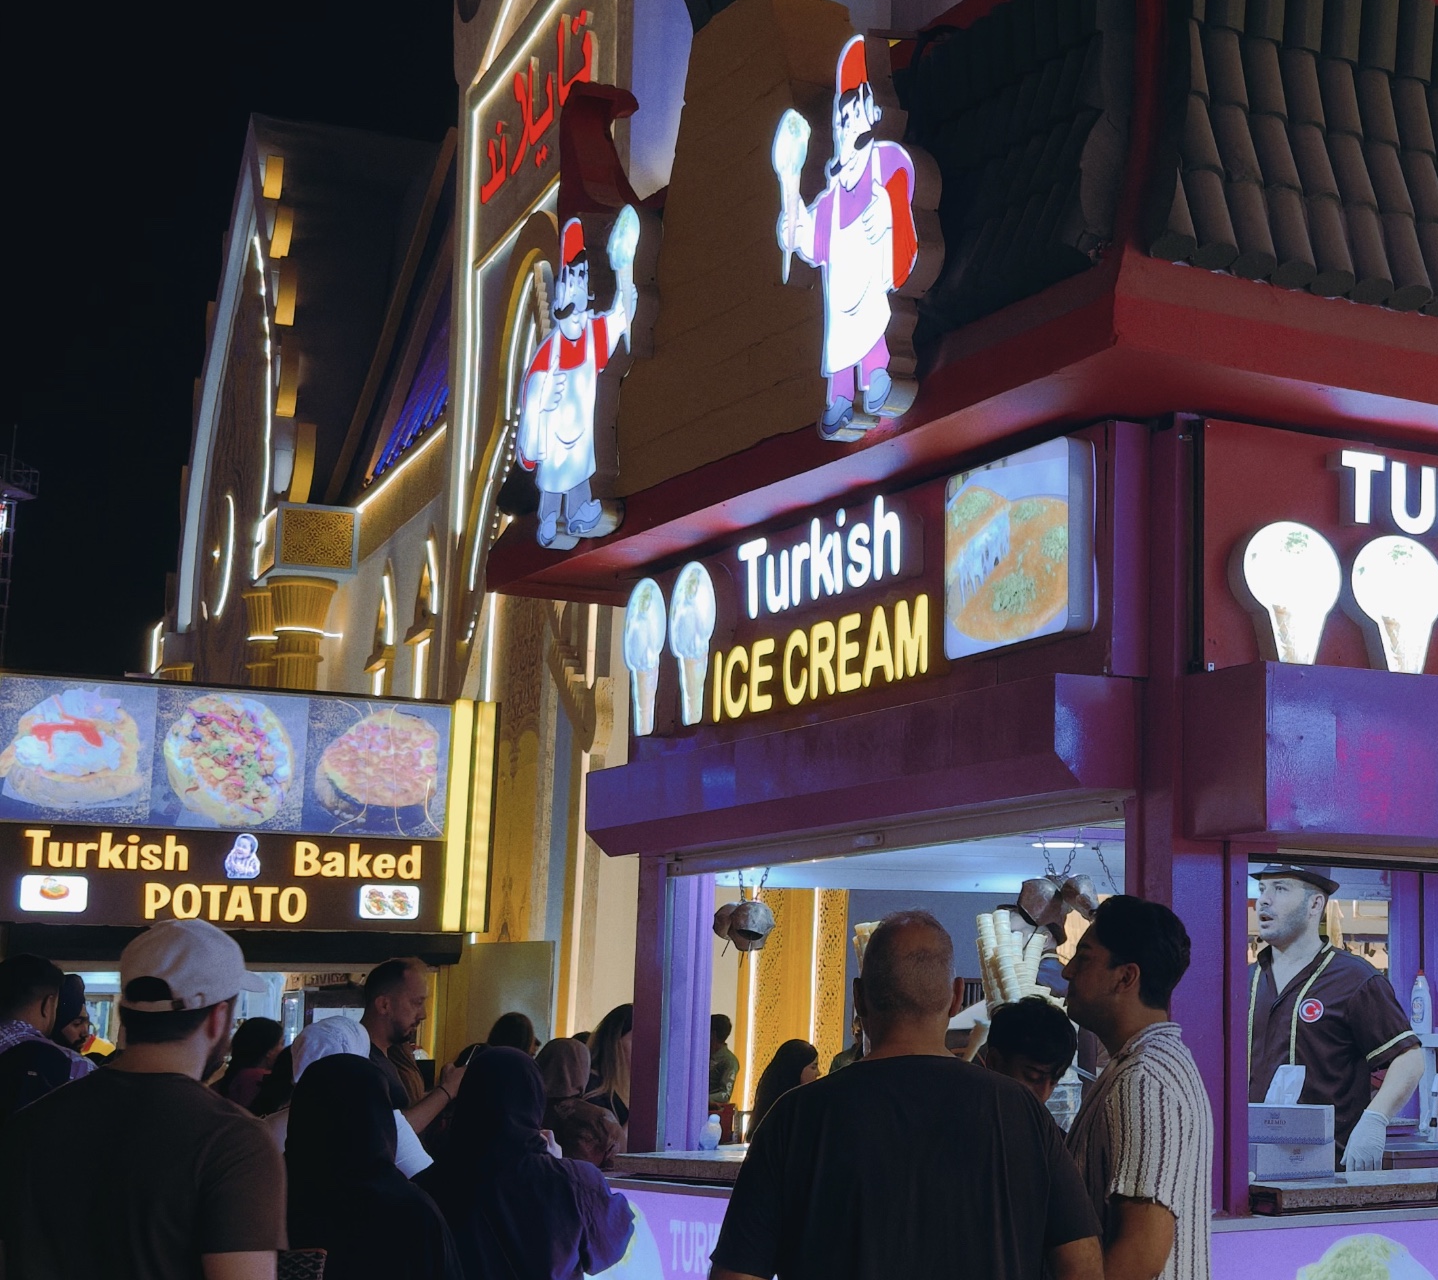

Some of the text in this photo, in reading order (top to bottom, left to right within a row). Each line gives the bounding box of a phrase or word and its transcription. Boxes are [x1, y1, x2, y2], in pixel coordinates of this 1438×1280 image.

[481, 9, 593, 205] تايلاند
[738, 495, 901, 620] Turkish
[712, 593, 929, 724] ICE CREAM
[24, 830, 422, 880] Turkish Baked
[143, 882, 308, 923] POTATO
